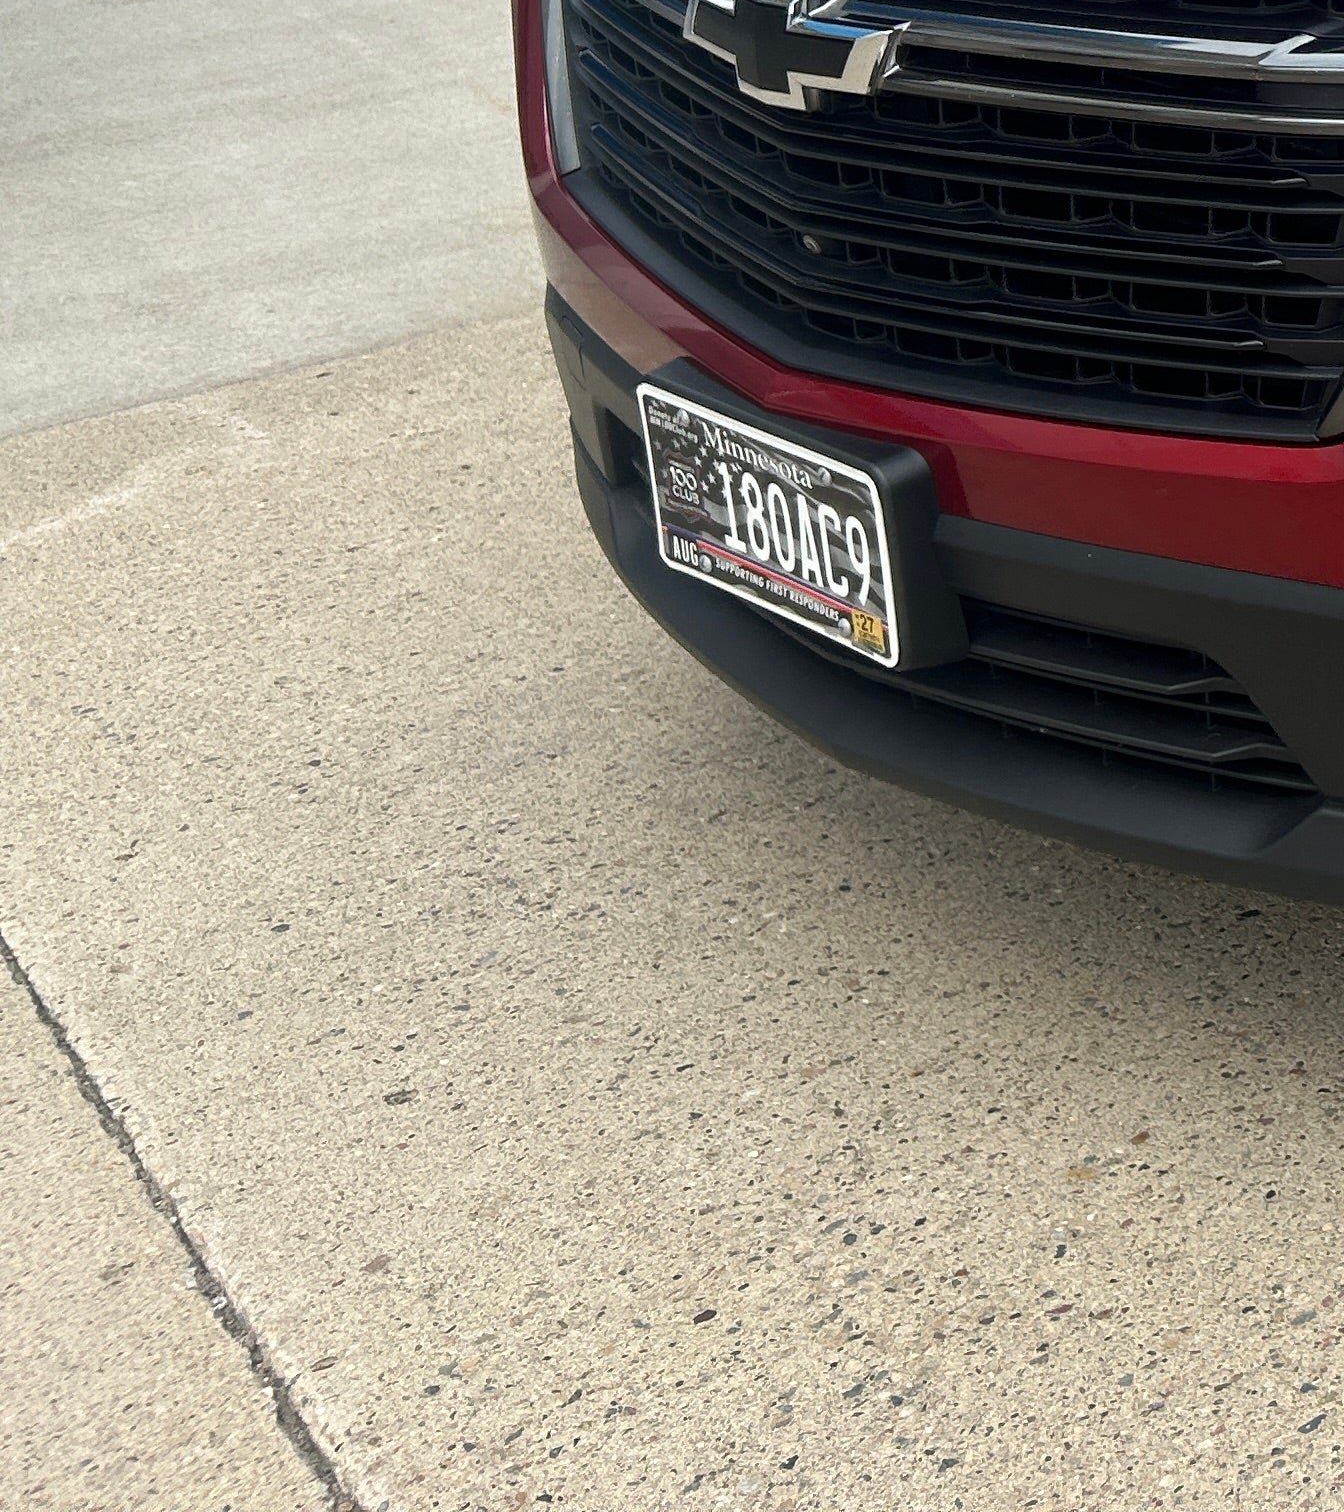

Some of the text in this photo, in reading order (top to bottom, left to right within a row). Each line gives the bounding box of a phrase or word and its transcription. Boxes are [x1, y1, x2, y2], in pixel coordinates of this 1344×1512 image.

[699, 420, 814, 491] Minnesota
[669, 465, 698, 492] 100
[672, 484, 700, 506] CLUB
[717, 461, 871, 607] 180AC9
[672, 535, 699, 568] AUG
[715, 557, 840, 622] SUPPORTING FIRST RESPONDERS
[859, 614, 874, 633] 27
